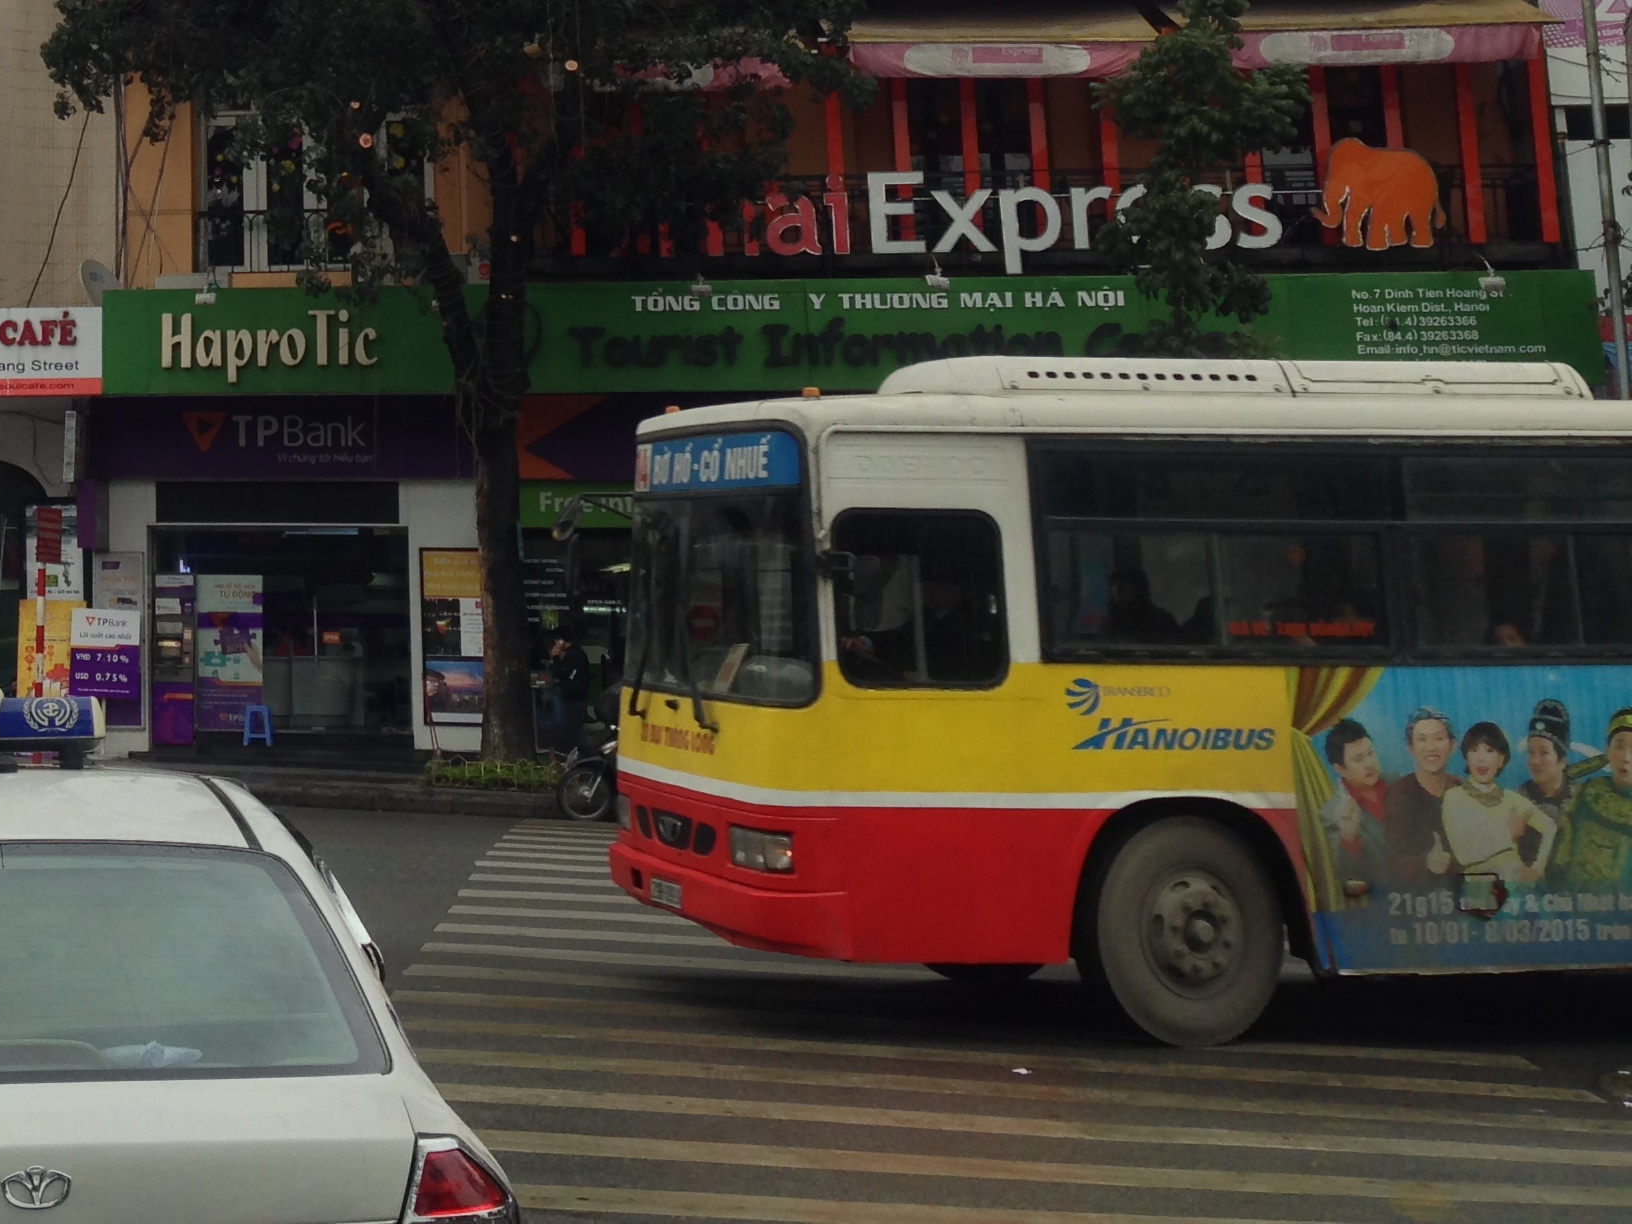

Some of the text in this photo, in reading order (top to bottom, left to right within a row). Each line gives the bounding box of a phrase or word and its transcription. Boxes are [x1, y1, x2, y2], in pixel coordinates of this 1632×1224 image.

[631, 287, 700, 313] TỔNG
[960, 291, 1013, 313] MẠI
[1078, 285, 1126, 311] NỘI
[1385, 289, 1413, 299] Dinh
[1417, 288, 1443, 298] Tien
[1446, 288, 1487, 300] Hoang
[1354, 304, 1384, 314] Hoan
[1387, 303, 1418, 313] Kiem
[0, 311, 77, 346] CAFÉ
[31, 359, 79, 371] Street
[232, 415, 366, 447] TPBank
[97, 617, 128, 627] TPBank
[75, 672, 128, 683] USD 0.75%
